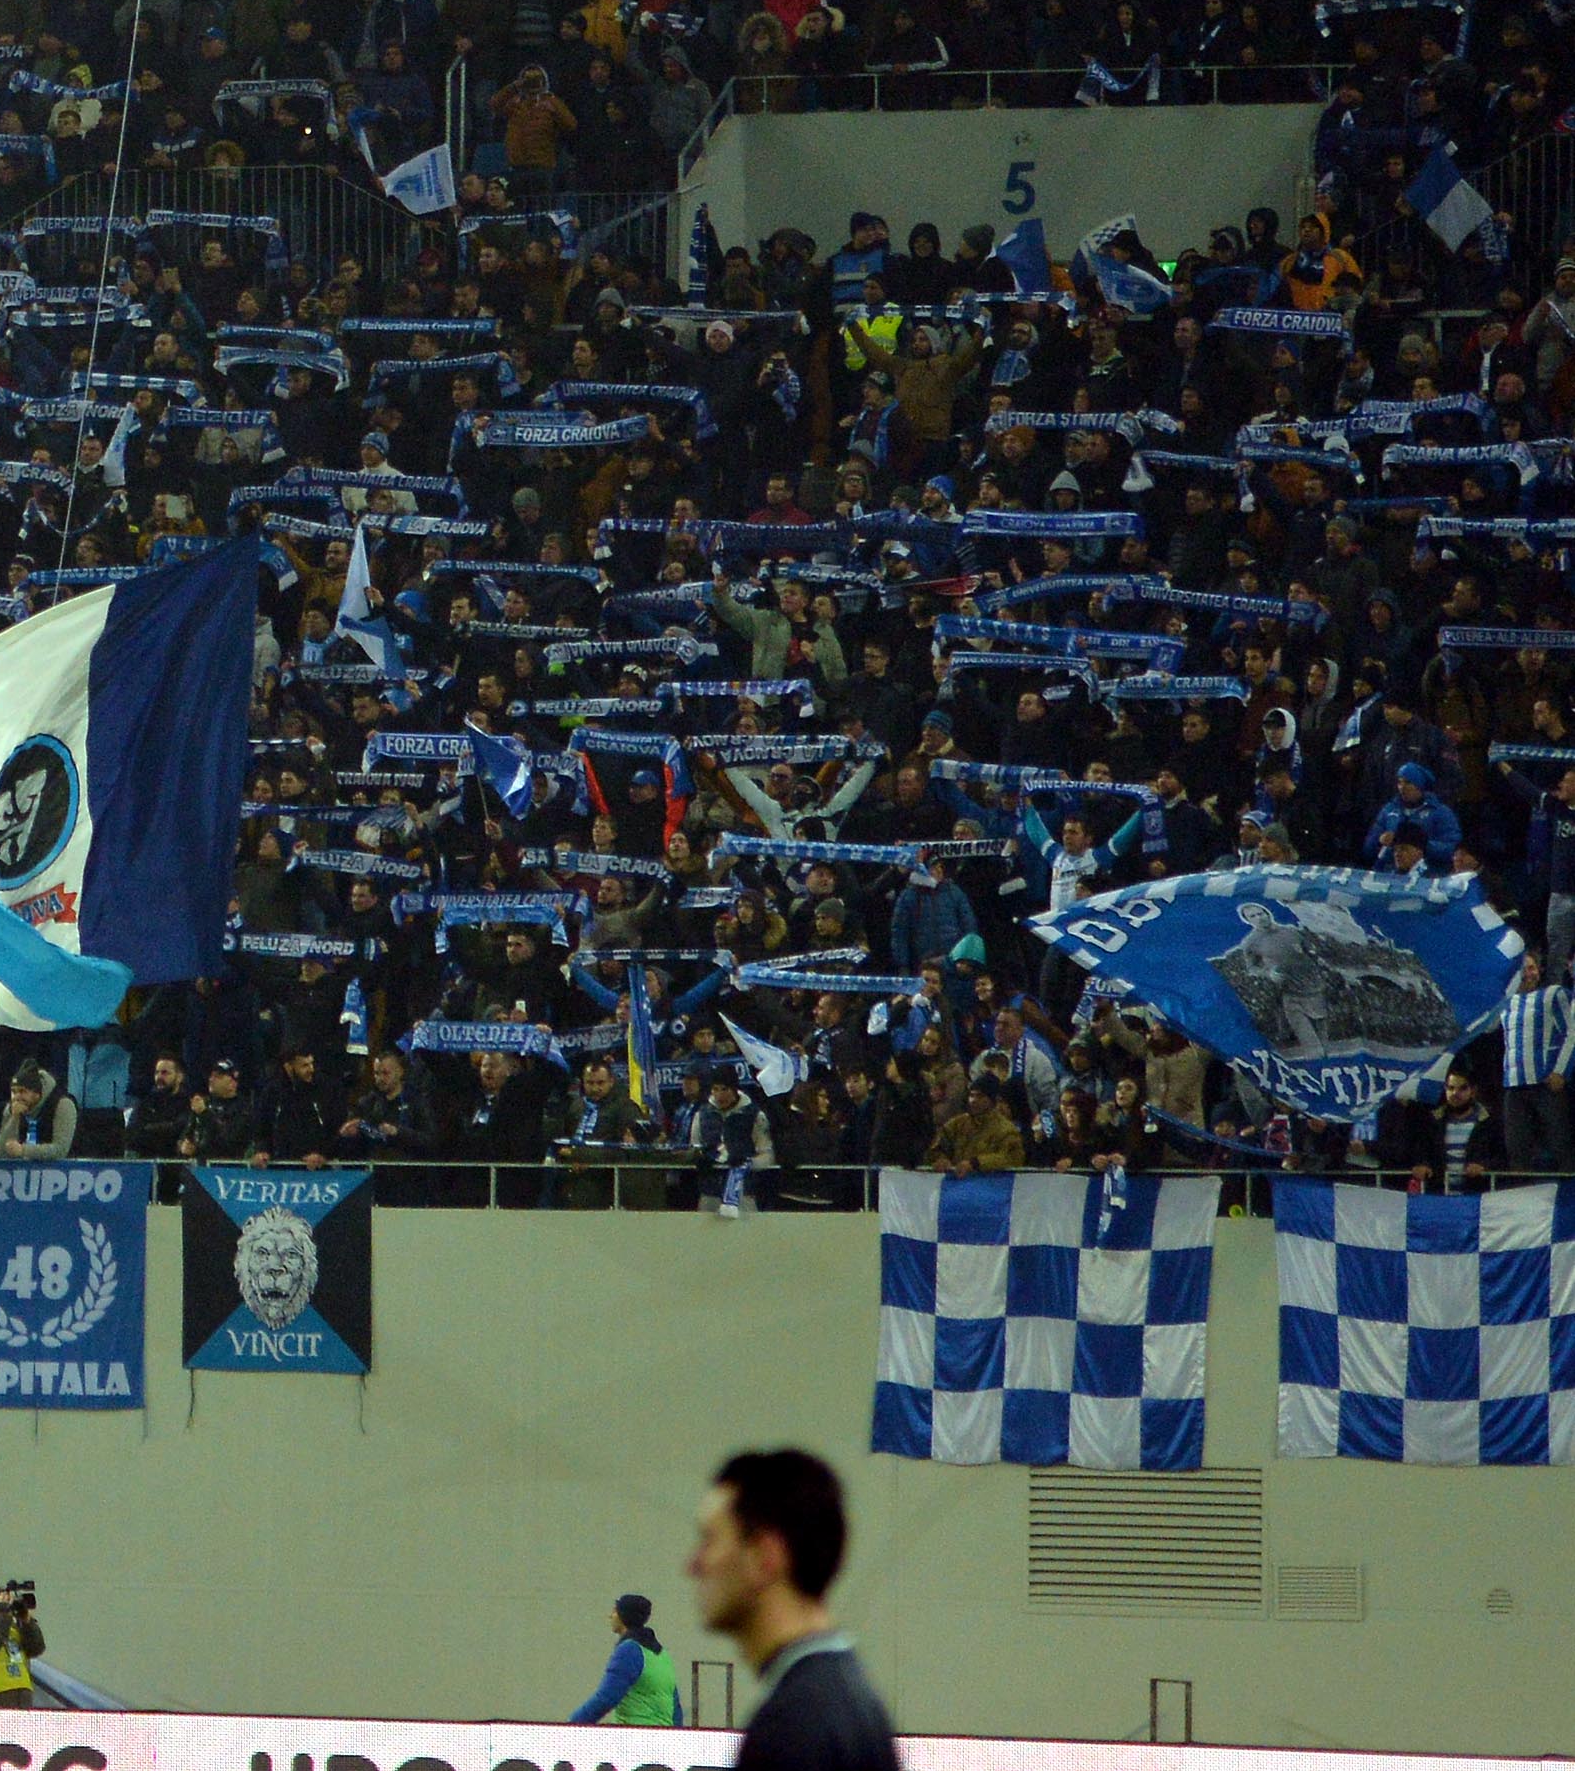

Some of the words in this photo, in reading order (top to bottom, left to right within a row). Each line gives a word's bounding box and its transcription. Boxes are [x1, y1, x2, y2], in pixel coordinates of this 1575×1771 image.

[1002, 160, 1037, 216] 5
[1233, 311, 1278, 328] FORZA
[1281, 313, 1343, 332] CRAIOVA
[1008, 412, 1057, 428] FORZA
[514, 426, 560, 444] FORZA
[561, 425, 621, 443] CRAIOVA
[311, 467, 400, 489] UNIVERSITATEA
[1140, 585, 1229, 611] UNIVERSITATEA
[1232, 594, 1284, 615] CRAIOVA
[612, 698, 664, 713] NORD
[385, 736, 434, 755] FORZA
[302, 850, 366, 872] PELUZA
[373, 859, 421, 879] NORD
[241, 936, 302, 955] PELUZA
[310, 938, 355, 955] NORD
[214, 1175, 339, 1207] VERITAS
[0, 1245, 71, 1302] 48
[227, 1330, 324, 1363] VINCIT
